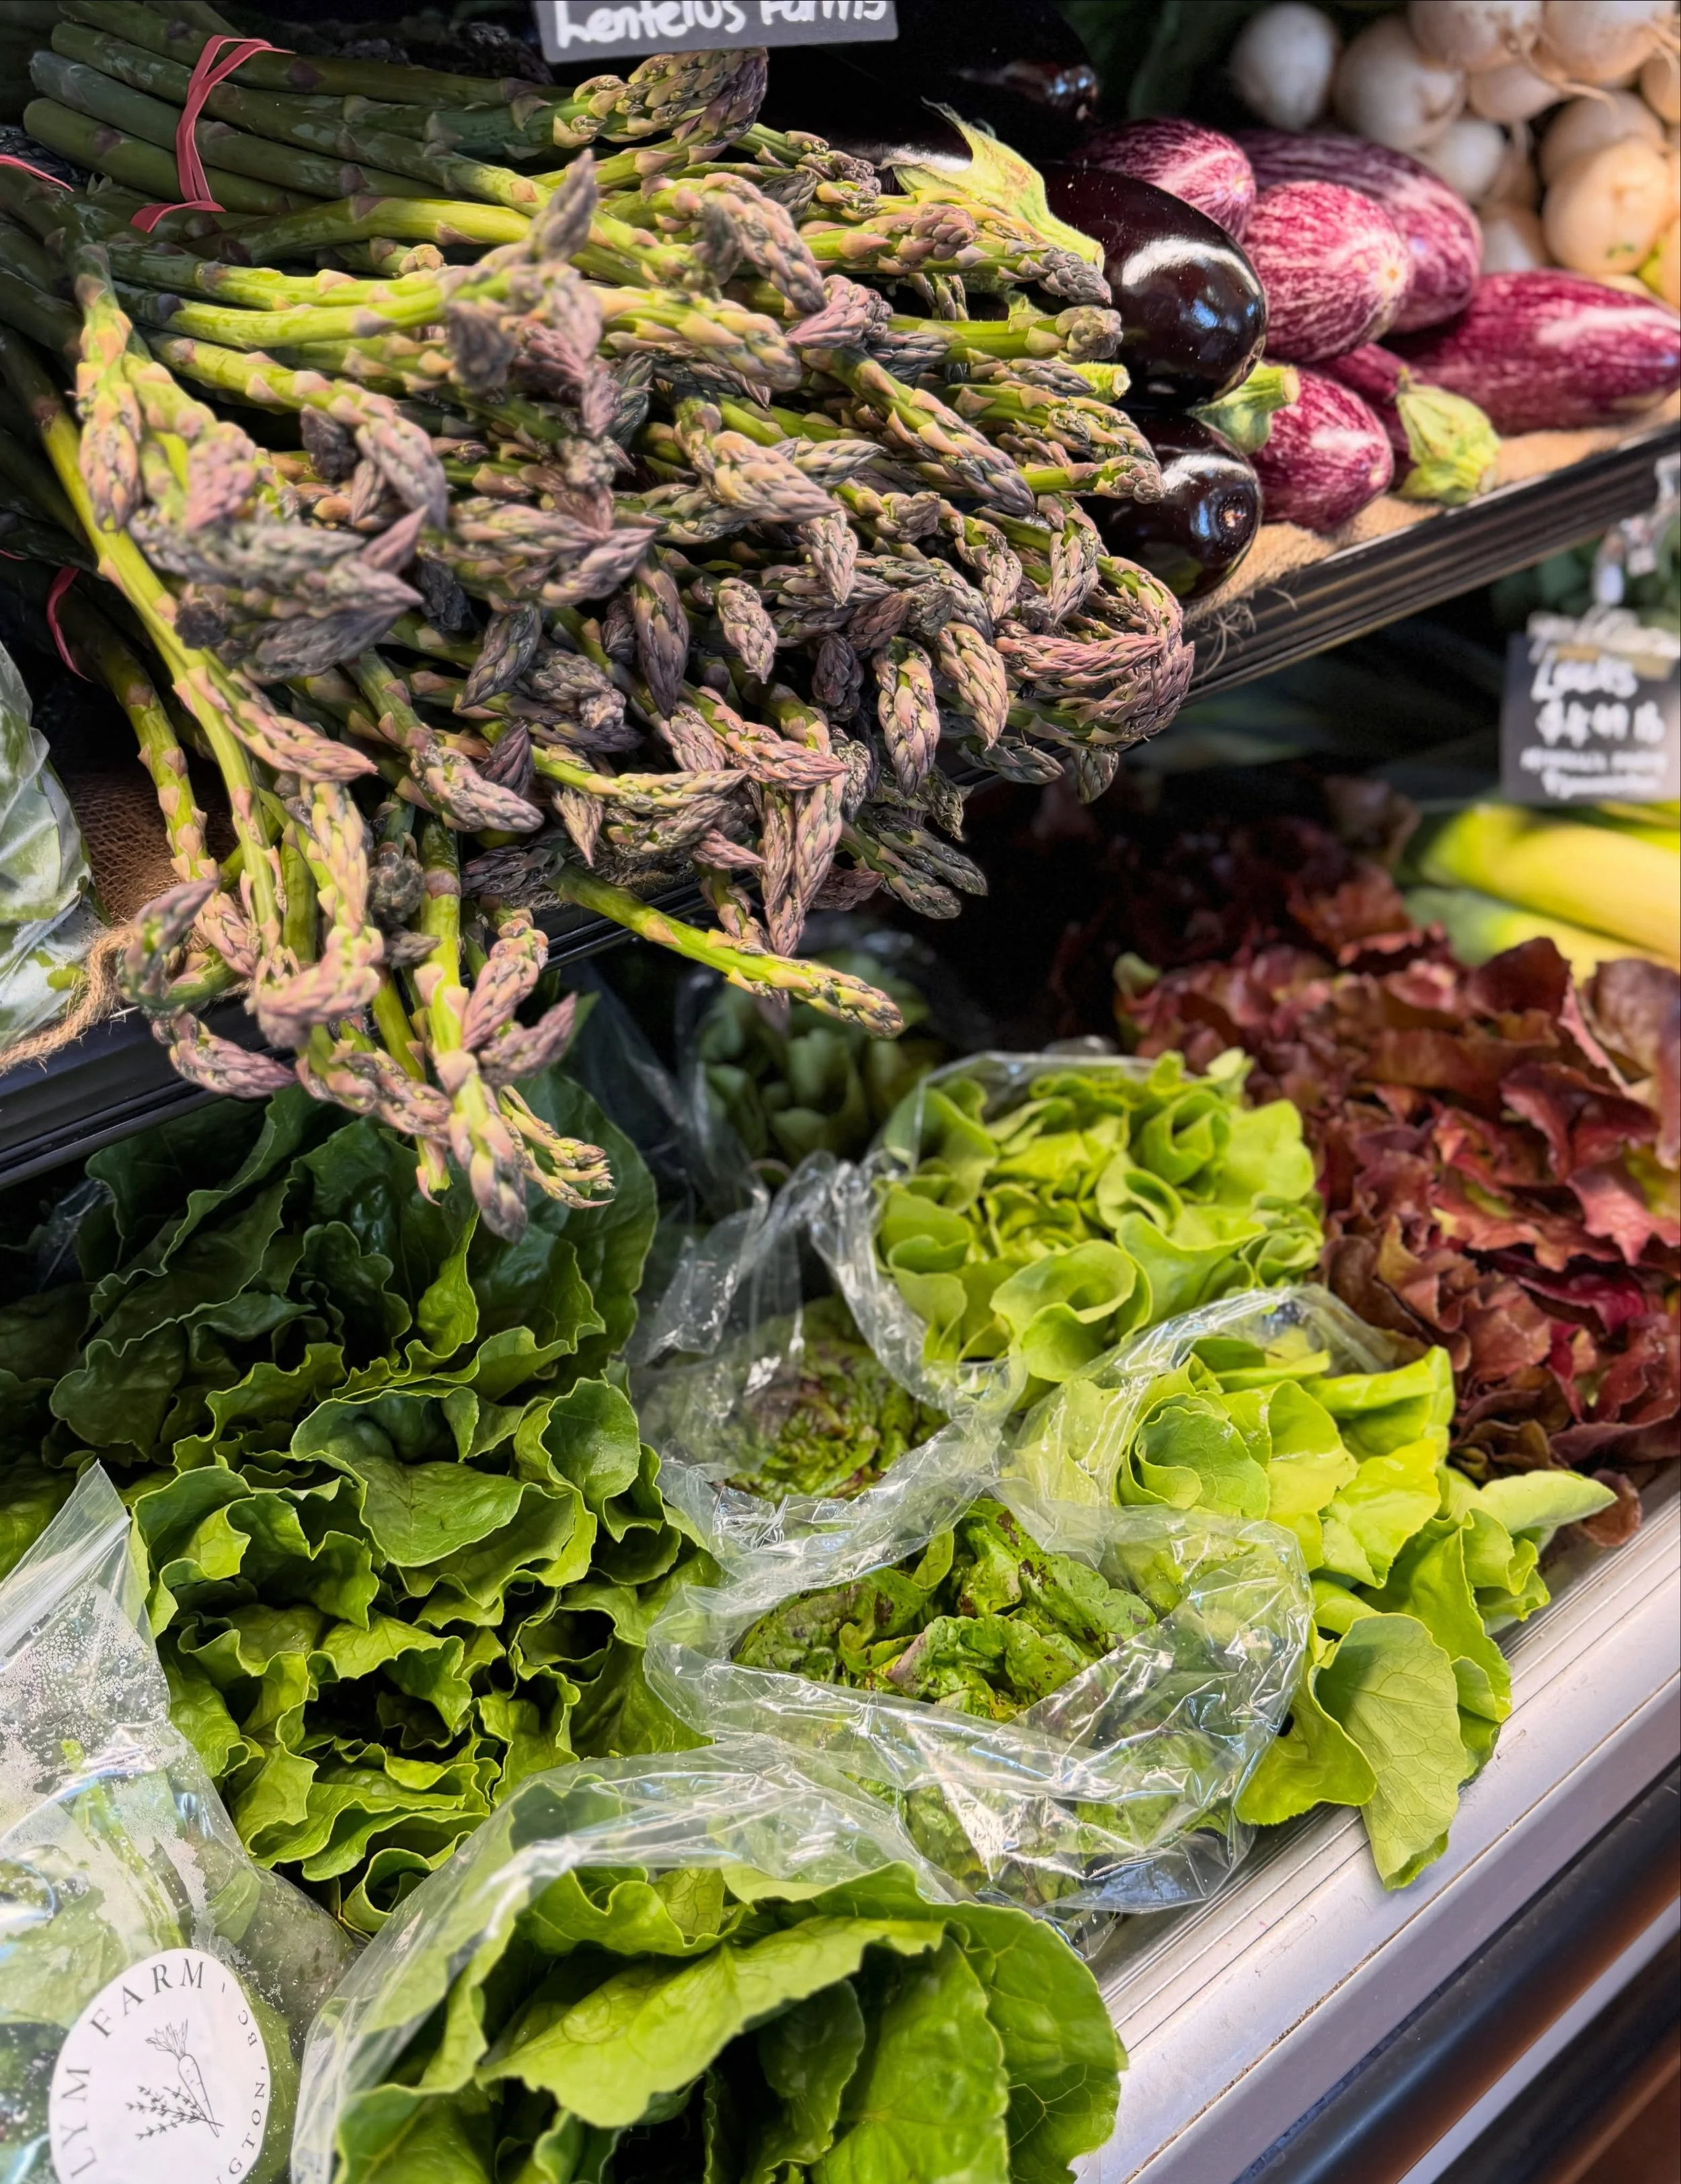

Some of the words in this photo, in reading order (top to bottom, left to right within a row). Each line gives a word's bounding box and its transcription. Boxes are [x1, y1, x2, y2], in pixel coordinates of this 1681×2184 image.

[59, 2066, 97, 2179] LYM
[89, 1957, 205, 2039] FARM
[237, 2009, 258, 2047] BC
